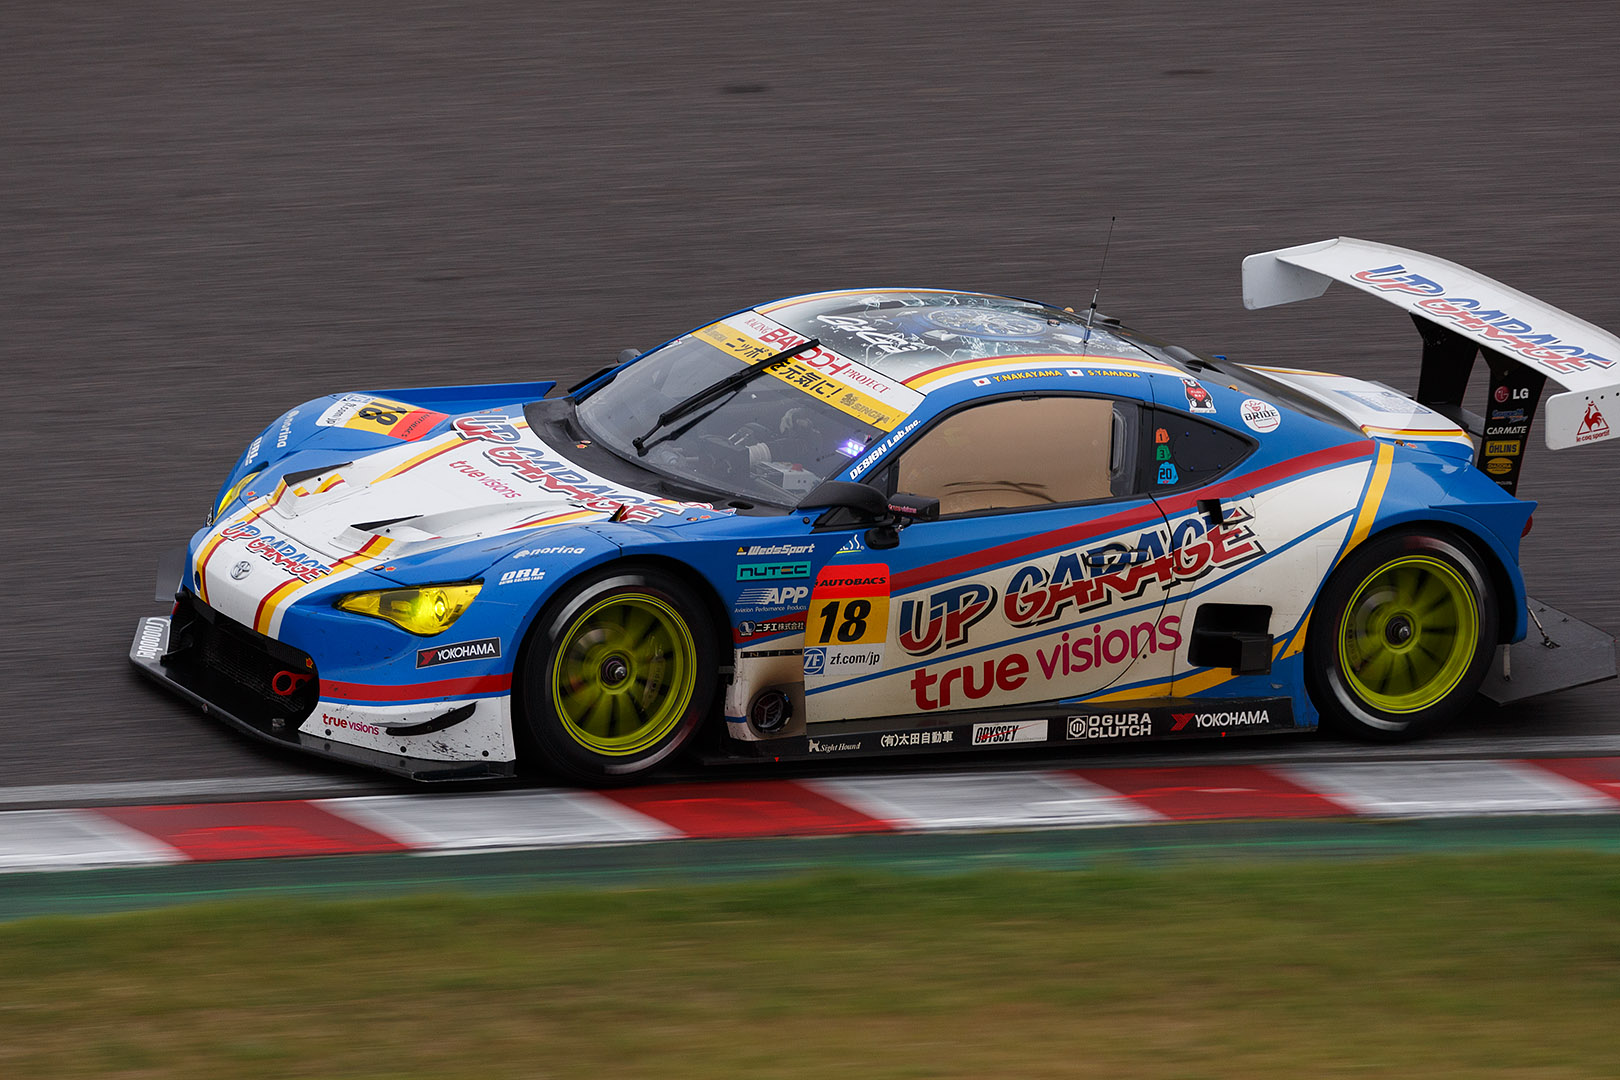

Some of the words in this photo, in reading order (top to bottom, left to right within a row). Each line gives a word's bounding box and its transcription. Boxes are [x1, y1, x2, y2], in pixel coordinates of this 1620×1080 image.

[1350, 264, 1445, 297] UP
[1413, 297, 1617, 374] GARAGE
[843, 368, 891, 394] PROJECT
[993, 369, 1063, 383] Y.NAKAYAMA
[1087, 369, 1140, 379] S.YAMADA
[1512, 388, 1529, 399] LG
[1244, 409, 1278, 421] BRIDE
[452, 415, 522, 445] UP
[1486, 426, 1528, 435] CARMATE
[449, 460, 482, 480] true
[480, 474, 522, 499] visions
[1159, 468, 1172, 480] 20
[482, 446, 685, 523] GARAGE
[220, 521, 261, 541] UP
[245, 535, 334, 584] GARAGE
[747, 543, 815, 556] WedsSport
[820, 576, 887, 587] AUTOBACS
[899, 583, 998, 656] UP
[1002, 500, 1268, 628] GARAGE
[763, 586, 809, 605] APP
[819, 600, 872, 643] 18
[436, 642, 496, 661] YOKOHAMA
[829, 651, 881, 666] zf.com/jp
[910, 654, 1030, 711] true
[1035, 614, 1184, 681] visions
[322, 713, 348, 729] true
[347, 720, 380, 736] visions
[1088, 713, 1153, 727] OGURA
[1194, 710, 1270, 728] YOKOHAMA
[880, 730, 953, 747] (有)太田自動車
[974, 724, 1019, 744] ODYSSEY
[1088, 723, 1153, 738] CLUTCH
[820, 743, 838, 754] Sight
[838, 741, 862, 752] Hound
